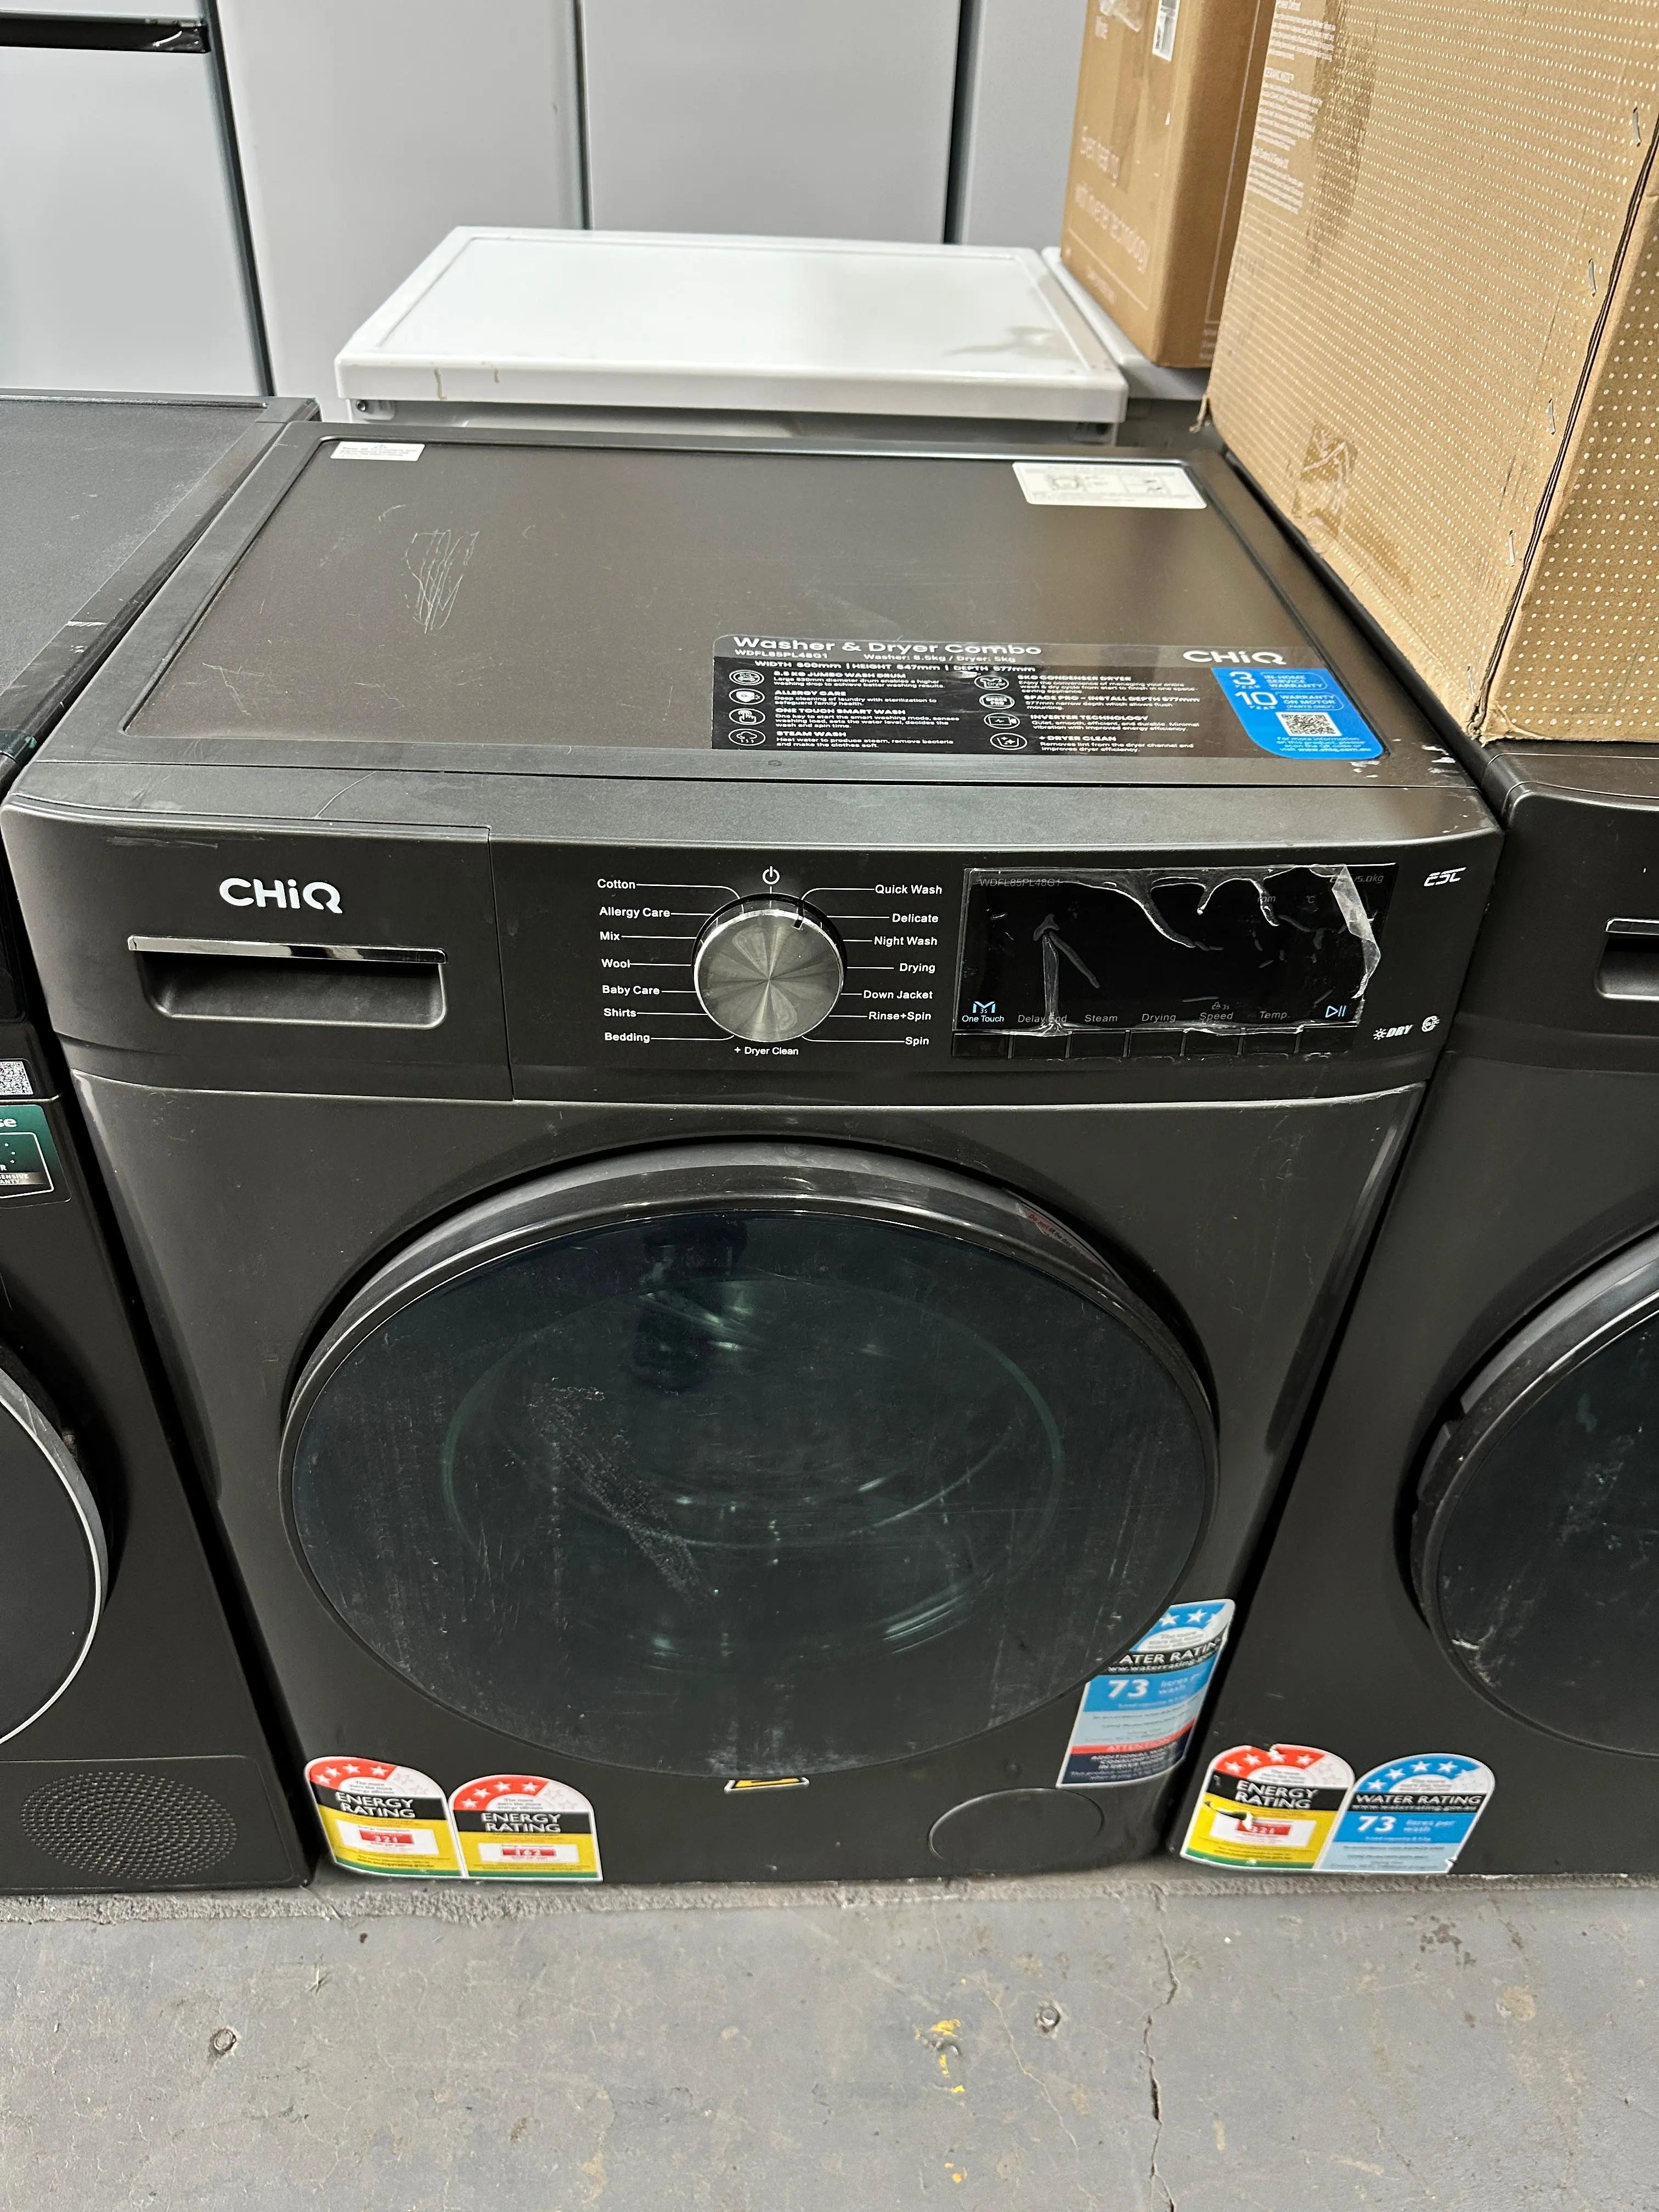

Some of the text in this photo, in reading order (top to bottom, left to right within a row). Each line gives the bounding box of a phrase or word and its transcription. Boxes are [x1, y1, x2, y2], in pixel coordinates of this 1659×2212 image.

[733, 636, 1042, 655] Washer & Dryer Combo
[1183, 650, 1286, 665] CHiQ
[1229, 672, 1256, 685] 3
[1235, 692, 1278, 706] 10
[597, 878, 636, 889] Cotton
[874, 884, 943, 894] Quick Wash
[219, 877, 343, 914] CHiQ
[599, 906, 670, 919] Allergy Care
[892, 913, 939, 923] Delicate
[600, 931, 620, 941] Mix
[874, 936, 938, 947] Night Wash
[601, 958, 630, 968] Wool
[899, 963, 936, 974] Drying
[602, 985, 660, 996] Baby Care
[863, 990, 933, 1000] Down Jacket
[603, 1008, 637, 1018] Shirts
[868, 1011, 932, 1022] Rinse+Spin
[1017, 1014, 1046, 1023] Delay
[1141, 1013, 1176, 1023] Drying
[1199, 1012, 1234, 1022] Speed
[1385, 1024, 1414, 1038] DRY
[604, 1032, 651, 1043] Bedding
[905, 1036, 930, 1047] Spin
[744, 1046, 770, 1056] Dryer
[771, 1047, 799, 1056] Clean
[1119, 1653, 1165, 1664] ATER
[1108, 1678, 1149, 1699] 73
[1236, 1779, 1319, 1799] ENERGY
[335, 1791, 414, 1809] ENERGY
[1234, 1791, 1313, 1809] RATING
[1356, 1794, 1483, 1805] WATER RATING
[340, 1802, 416, 1818] RATING
[481, 1812, 561, 1824] ENERGY
[1357, 1815, 1397, 1832] 73
[485, 1822, 561, 1833] RATING
